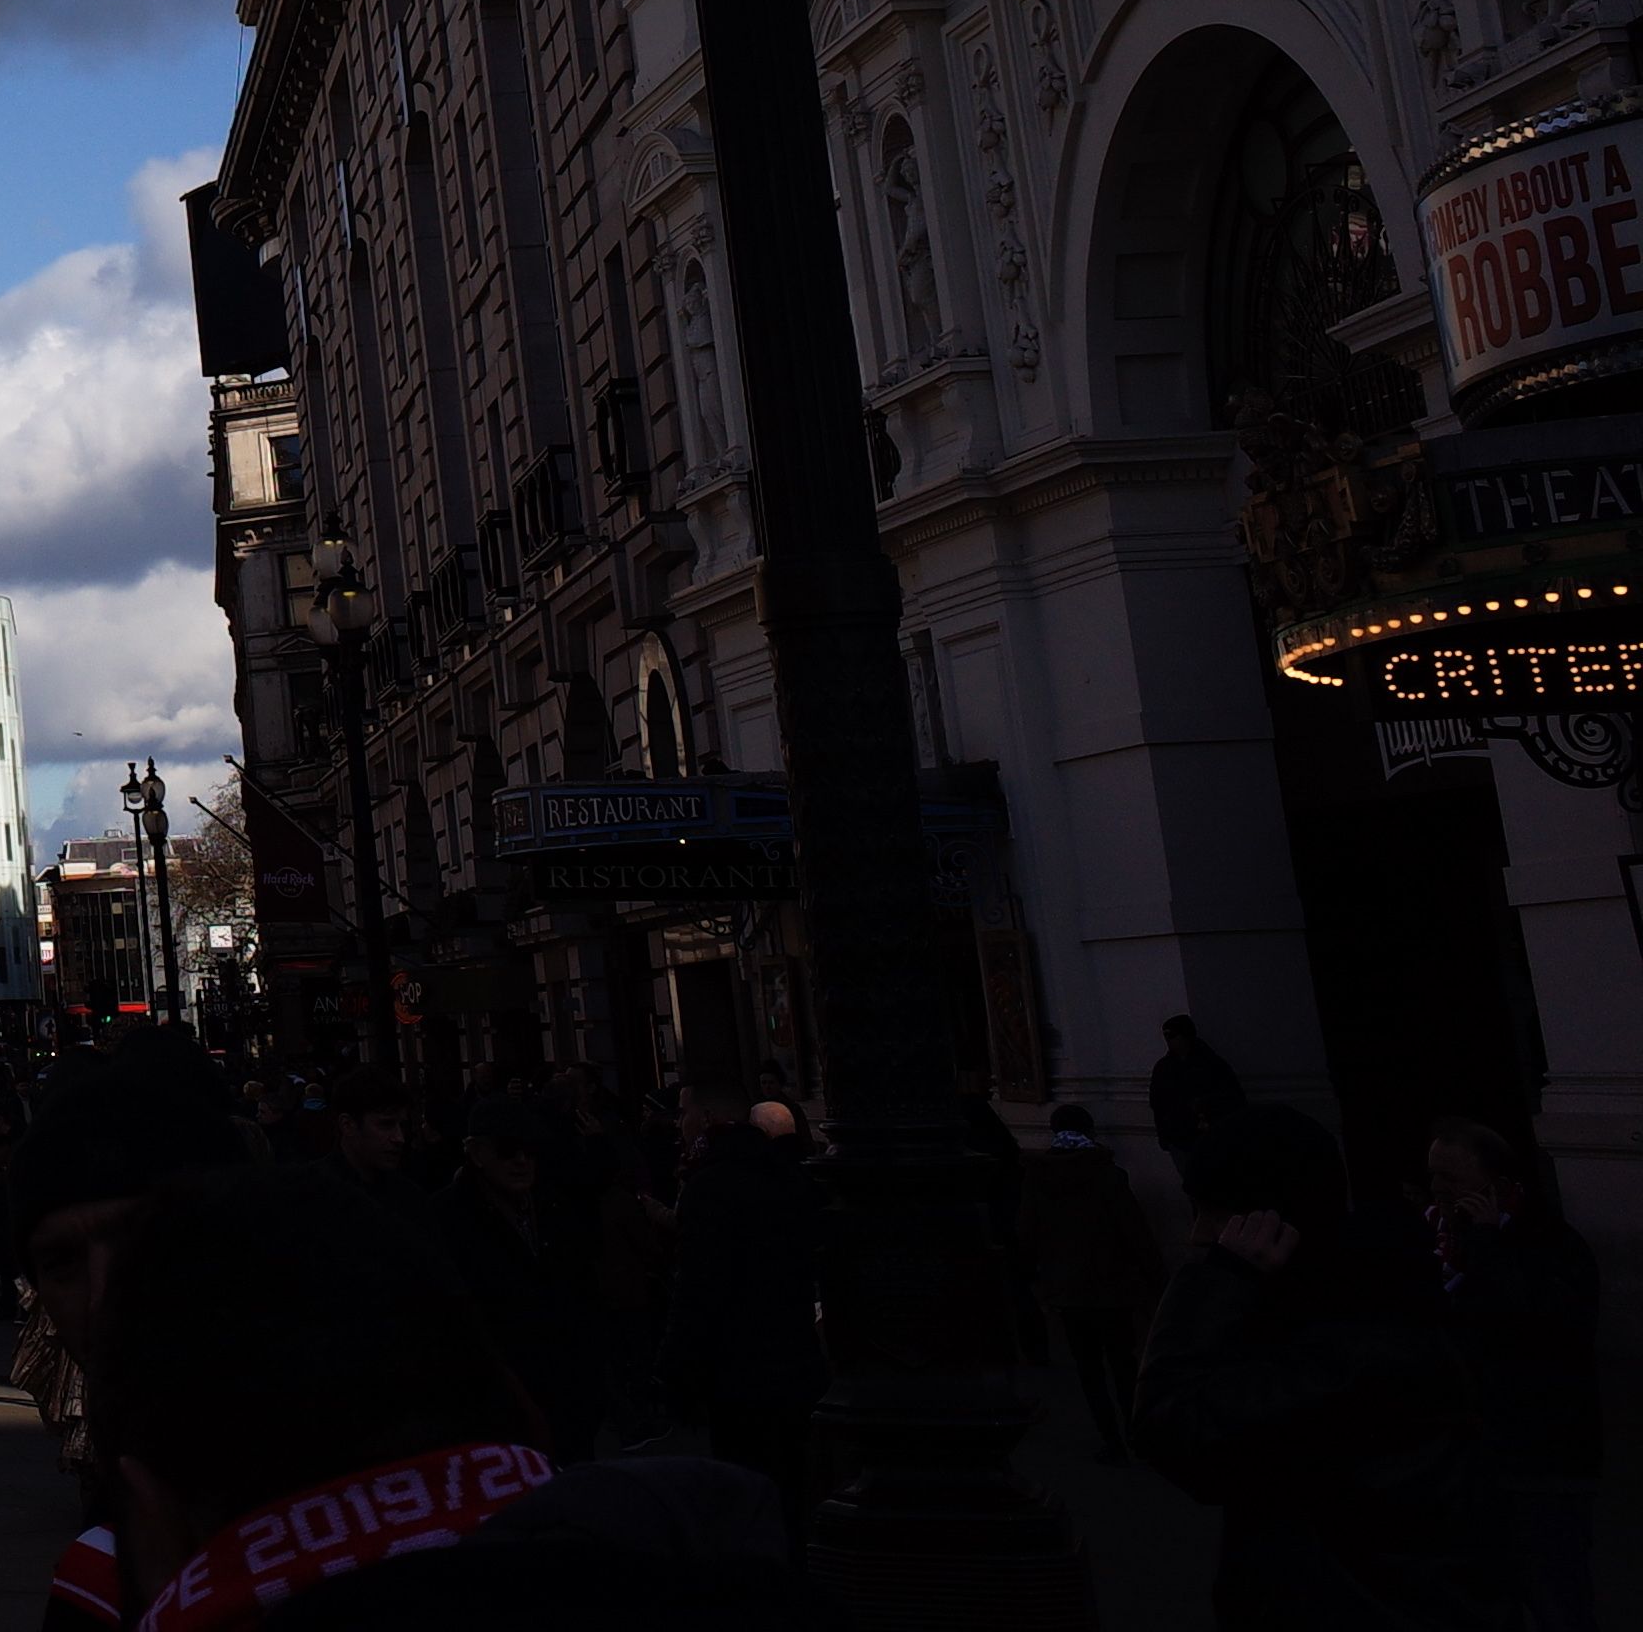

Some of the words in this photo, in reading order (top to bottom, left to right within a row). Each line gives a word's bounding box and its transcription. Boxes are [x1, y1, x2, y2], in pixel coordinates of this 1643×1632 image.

[1497, 151, 1590, 227] ABOUT
[1604, 144, 1632, 196] A
[547, 795, 702, 828] RESTAURANT
[262, 872, 288, 885] Hard
[289, 872, 315, 887] Rock
[237, 1441, 555, 1575] 2019/20
